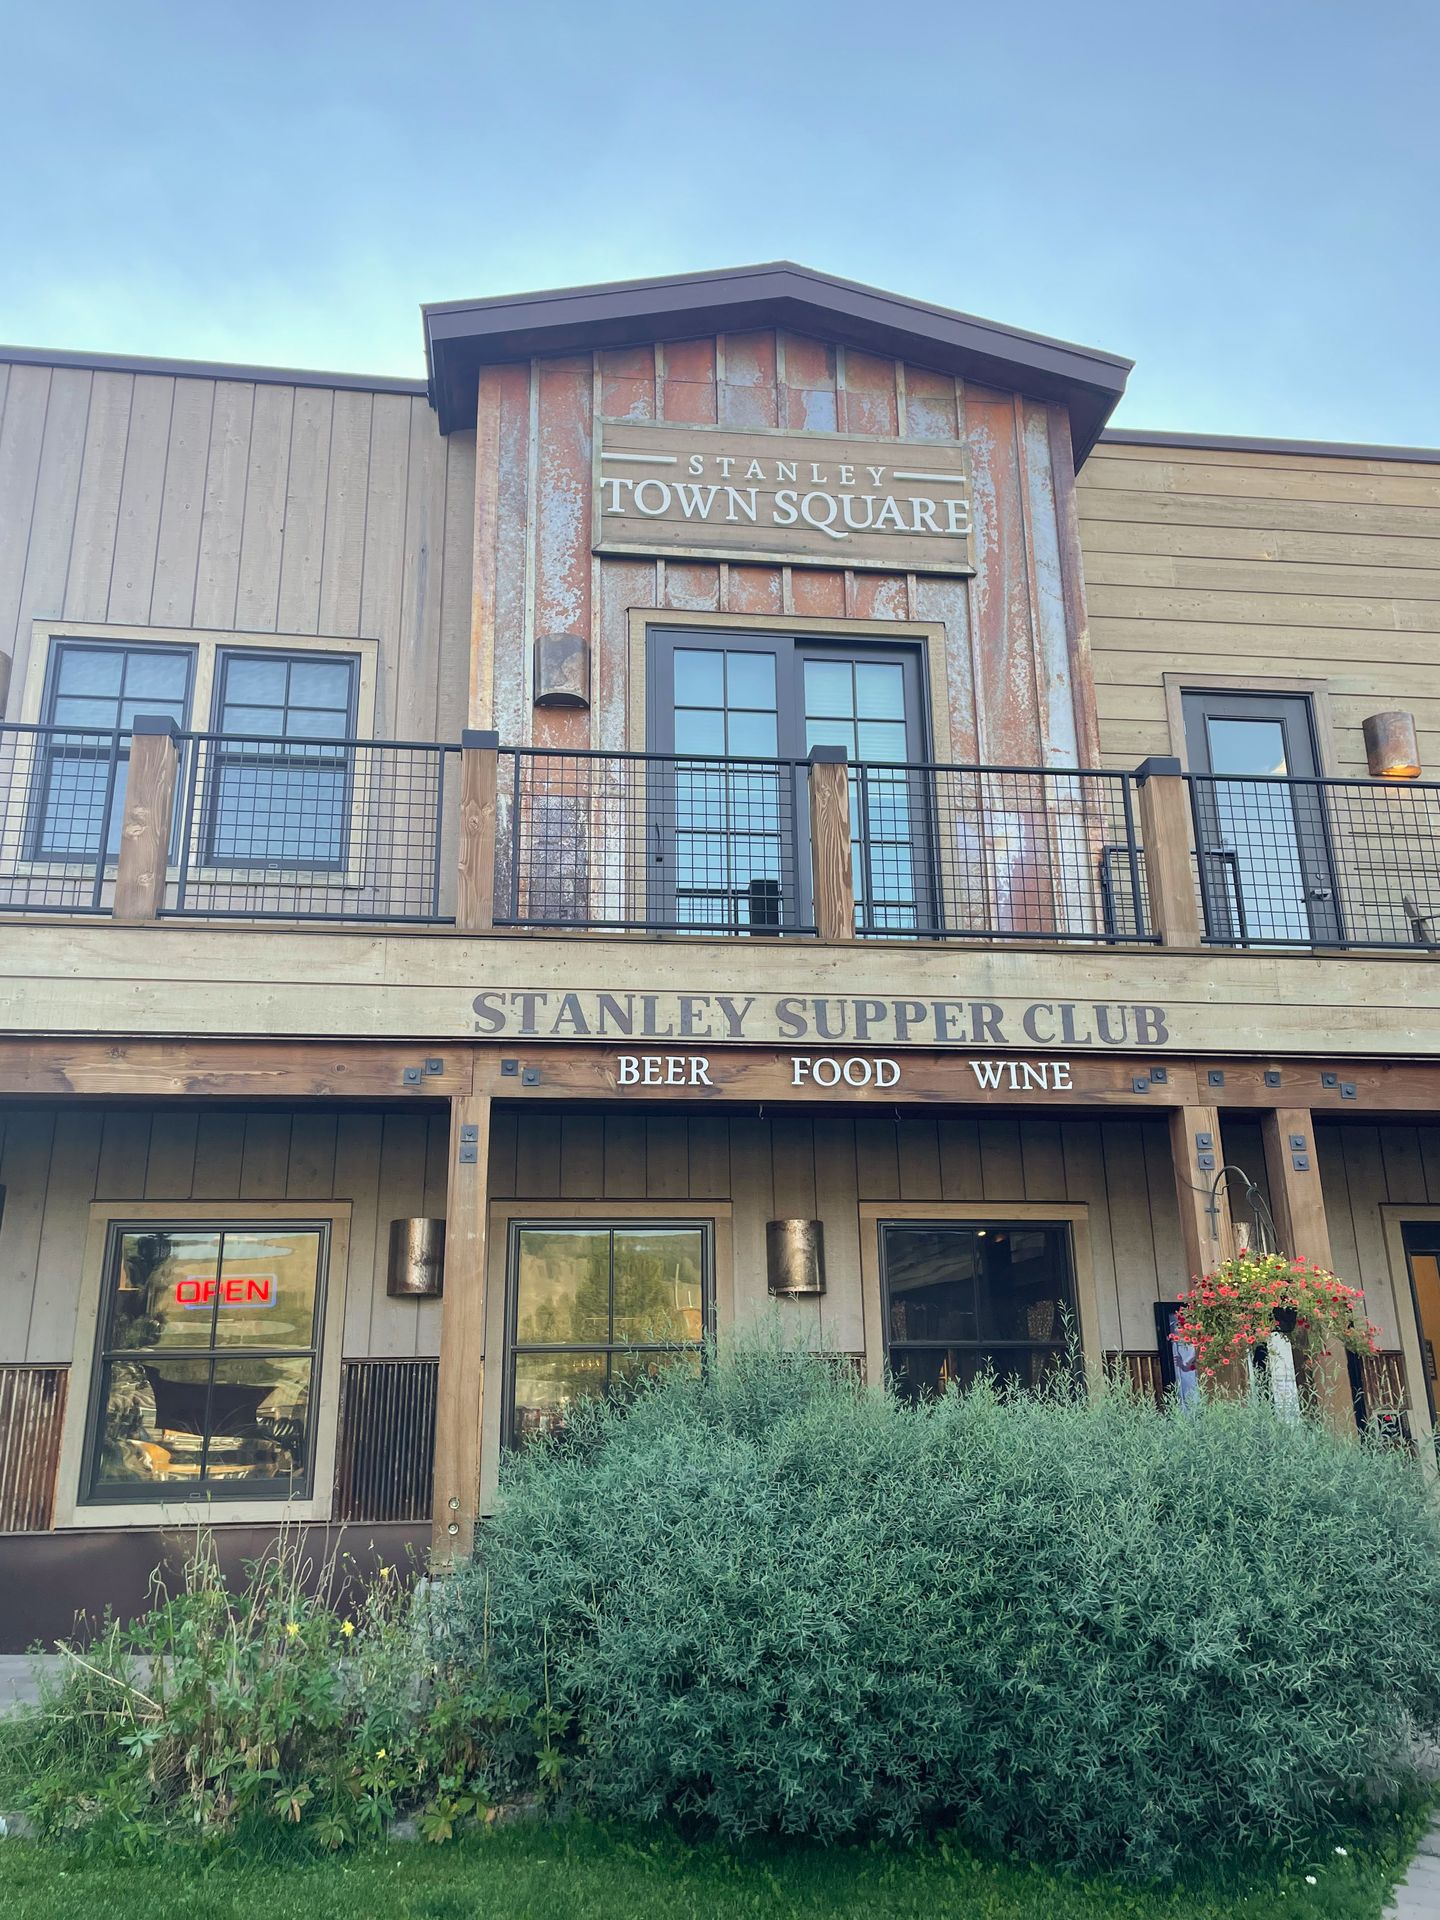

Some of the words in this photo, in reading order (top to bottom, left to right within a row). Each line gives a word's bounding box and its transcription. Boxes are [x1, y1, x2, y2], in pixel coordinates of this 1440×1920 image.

[688, 455, 886, 486] STANLEY
[600, 477, 759, 521] TOWN
[772, 490, 972, 538] SQUARE
[472, 992, 755, 1037] STANLEY
[775, 998, 1009, 1043] SUPPER
[1023, 1003, 1169, 1045] CLUB
[617, 1056, 713, 1086] BEER
[791, 1057, 900, 1087] FOOD
[969, 1061, 1072, 1090] WINE
[176, 1280, 269, 1303] OPEN
